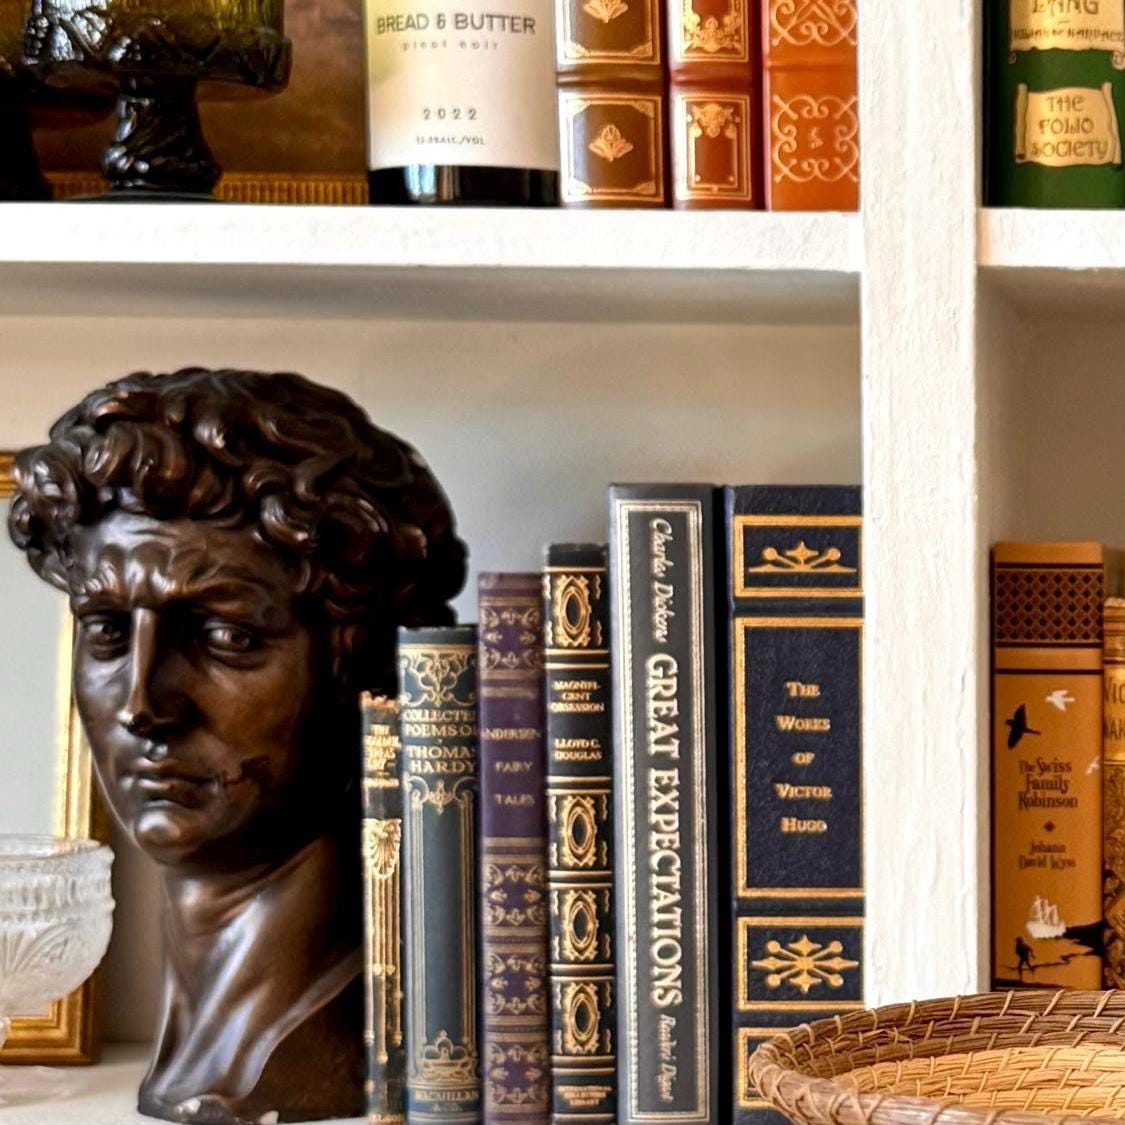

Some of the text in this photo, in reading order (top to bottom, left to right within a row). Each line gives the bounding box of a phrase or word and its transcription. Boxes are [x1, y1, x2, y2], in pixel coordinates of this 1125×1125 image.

[377, 13, 536, 34] BREAD & BUTTER
[403, 40, 500, 50] pinot noir
[423, 108, 477, 120] 2022
[1039, 118, 1094, 134] FOLIO
[650, 518, 674, 578] Charles
[651, 581, 675, 643] Dickens
[647, 653, 680, 758] GREAT
[405, 723, 458, 736] POEMS
[554, 750, 602, 761] DOUGLAS
[410, 759, 475, 773] HARDY
[1036, 756, 1072, 776] Swiss
[1026, 774, 1070, 795] Family
[1018, 791, 1079, 811] Robinson
[648, 768, 683, 1007] EXPECTATIONS
